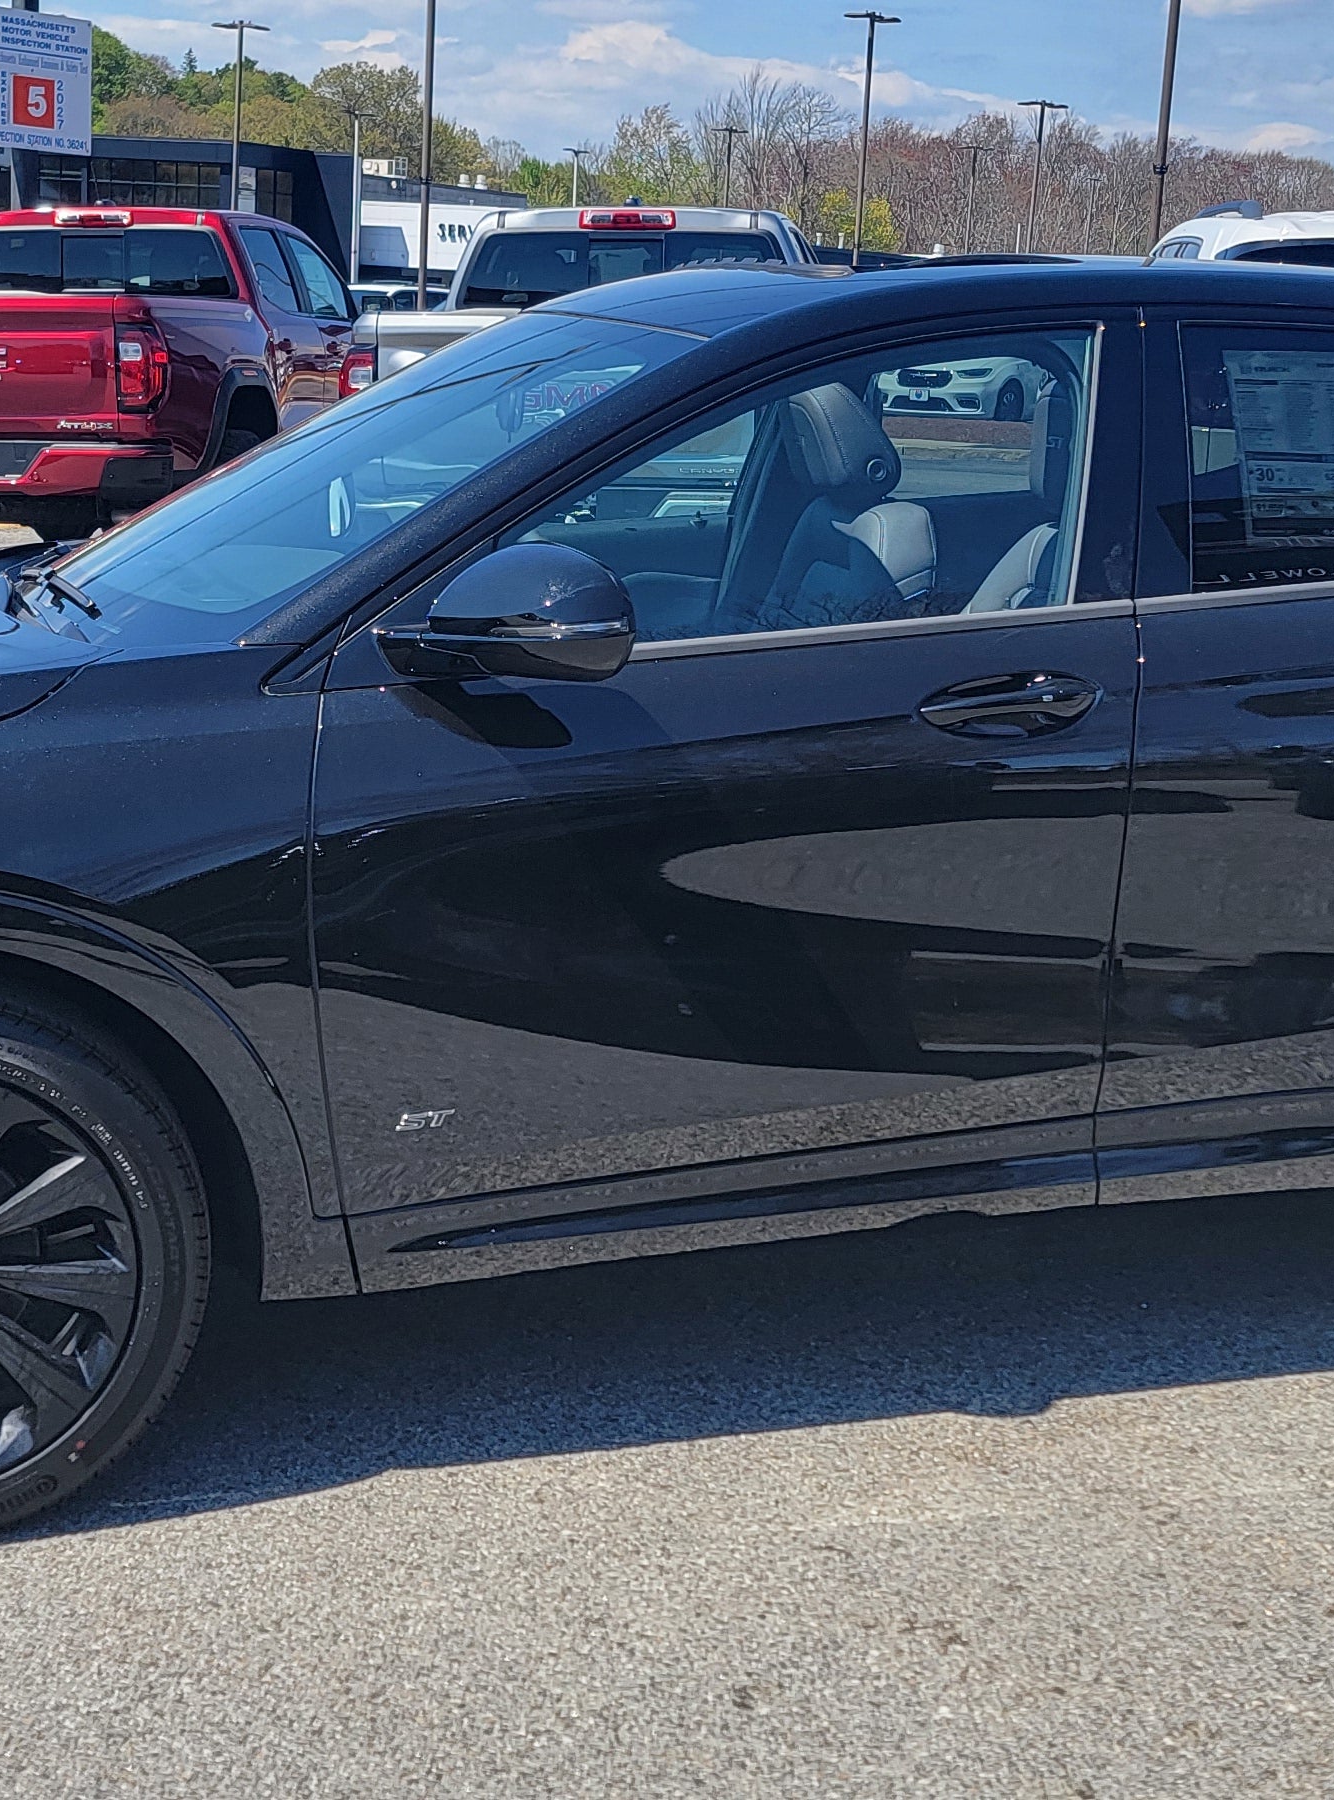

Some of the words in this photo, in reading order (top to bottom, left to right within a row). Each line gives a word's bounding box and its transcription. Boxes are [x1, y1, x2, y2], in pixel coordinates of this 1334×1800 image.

[1, 15, 76, 34] MASSACHUSETTS
[1, 26, 32, 37] MOTOR
[35, 31, 70, 43] VEHICLE
[1, 36, 51, 51] INSPECTION
[55, 44, 88, 55] STATION
[27, 85, 47, 118] 5
[56, 80, 64, 130] 2027
[27, 134, 53, 146] STATION
[55, 137, 66, 148] NO.
[395, 1108, 456, 1132] ST
